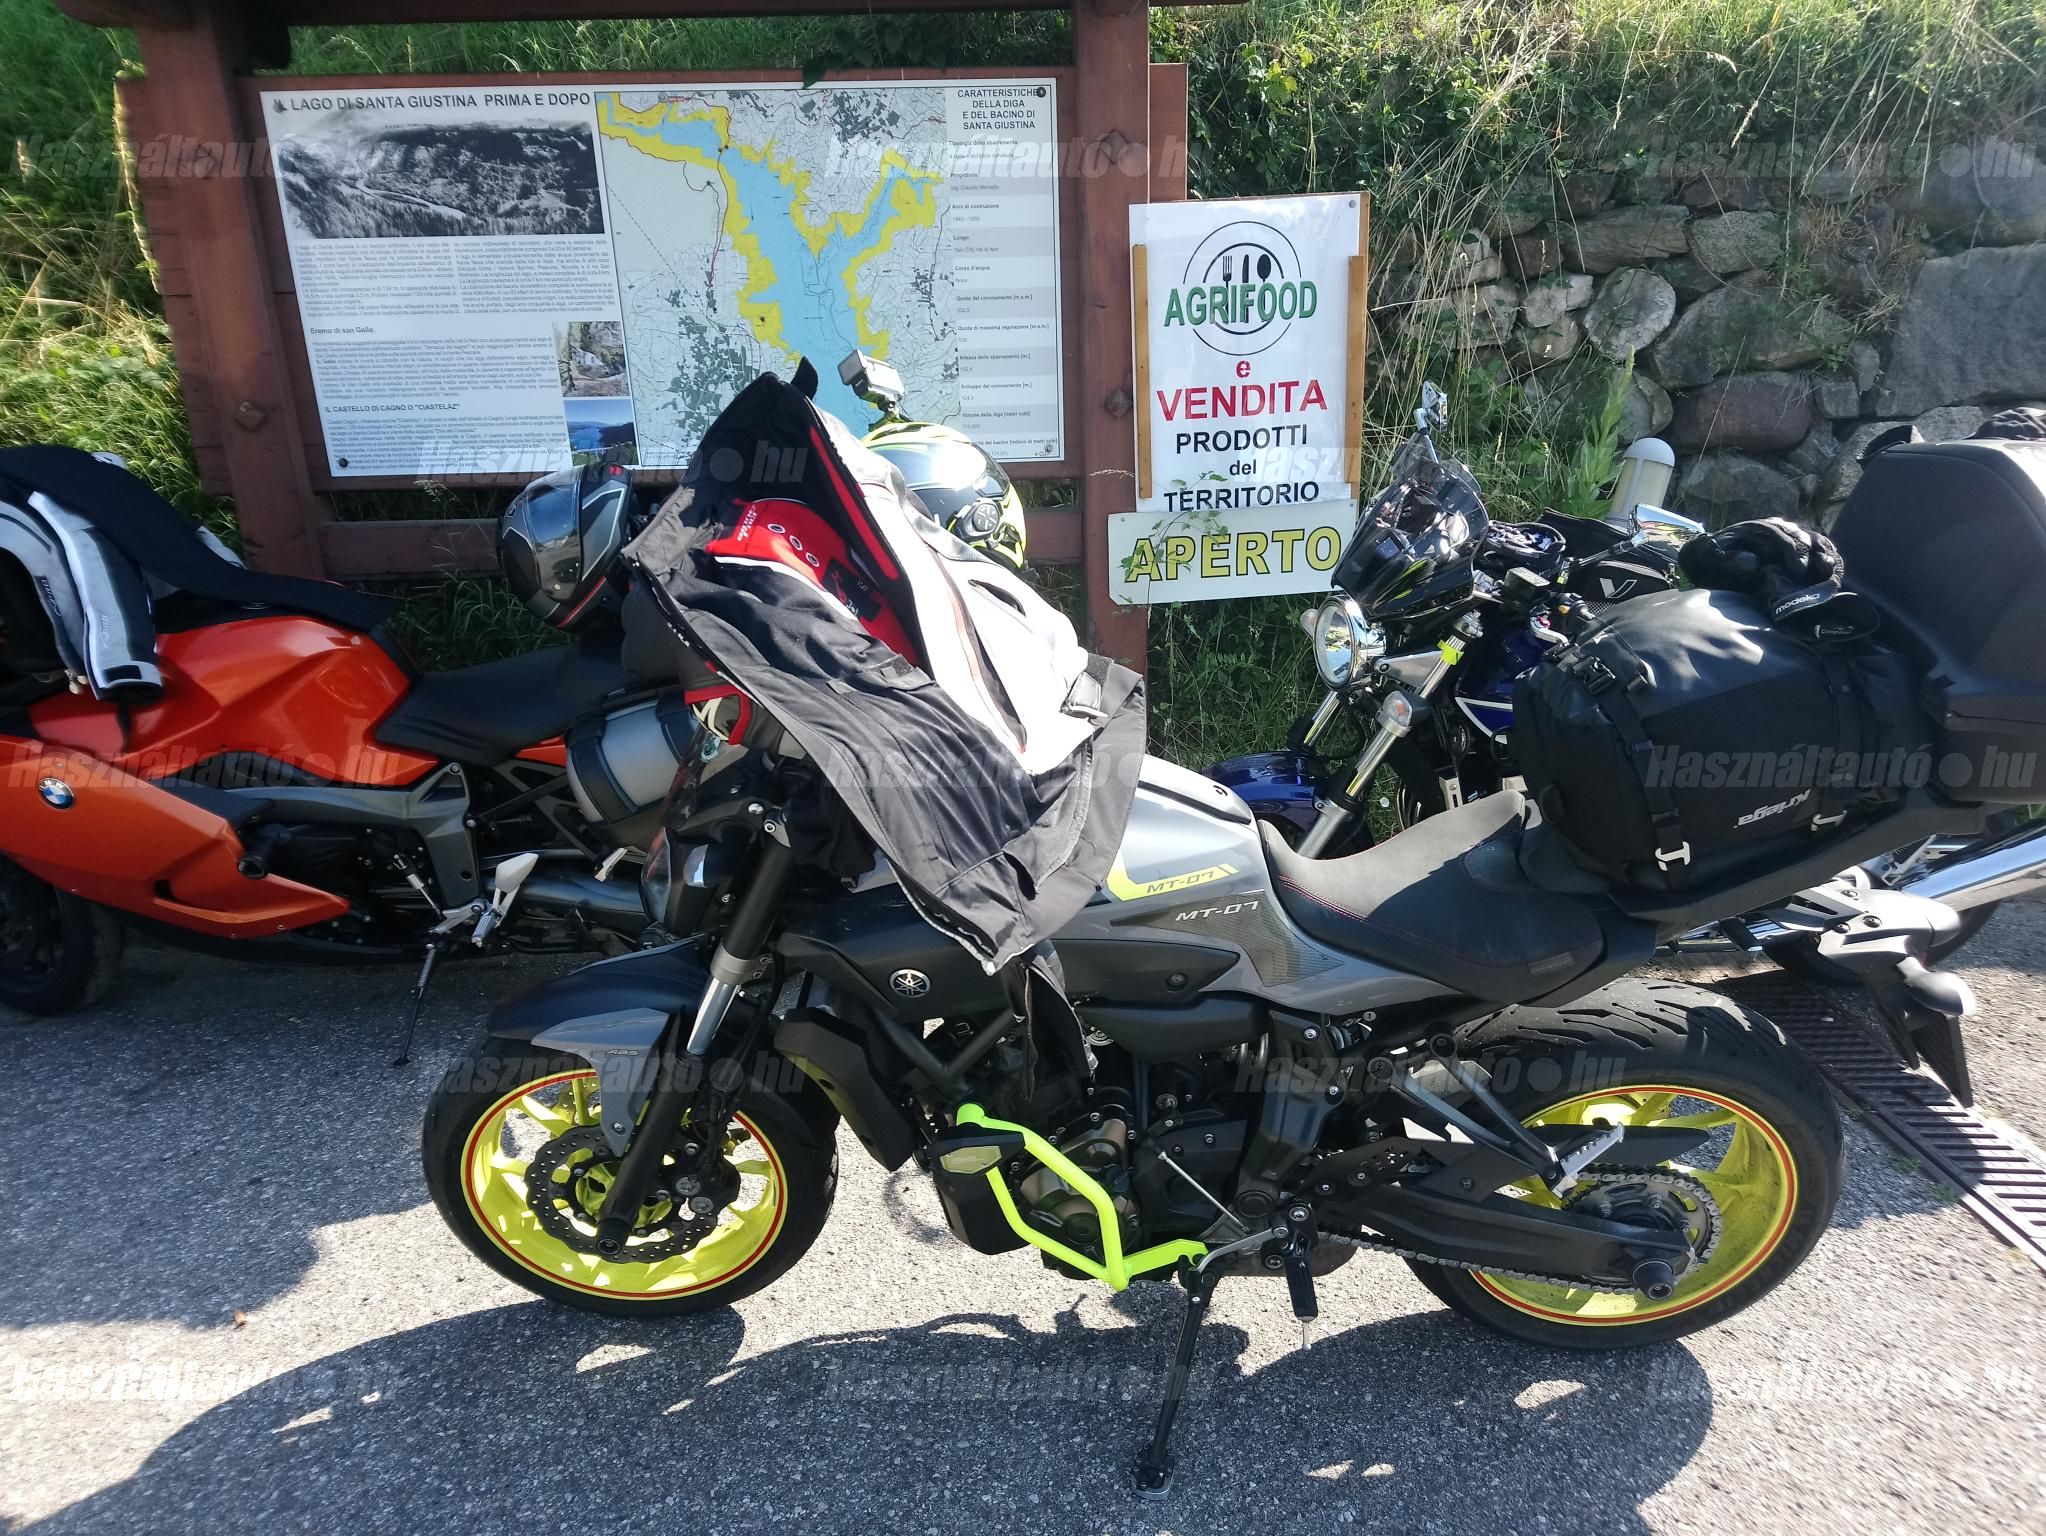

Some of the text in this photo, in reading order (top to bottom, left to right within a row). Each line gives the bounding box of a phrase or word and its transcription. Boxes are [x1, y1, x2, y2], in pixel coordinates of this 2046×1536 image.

[291, 92, 590, 111] LAGO DI SANTA GIUSTINA PRIMA E DOPO
[958, 88, 1038, 98] CARATTERISTICHE
[972, 99, 1025, 108] DELLA DIGA
[962, 110, 1035, 119] E DEL BACINO DI
[963, 121, 1035, 130] SANTA GIUSTINA
[1164, 280, 1318, 327] AGRIFOOD
[1236, 360, 1251, 378] e
[1156, 380, 1328, 422] VENDITA
[1176, 424, 1308, 454] PRODOTTI
[1229, 459, 1257, 477] del
[1164, 481, 1319, 512] TERRITORIO
[1125, 526, 1342, 582] APERTO
[1776, 593, 1820, 614] modeka
[1737, 788, 1812, 826] Kriega
[1146, 870, 1215, 894] MT-07
[1174, 900, 1259, 922] MT-07
